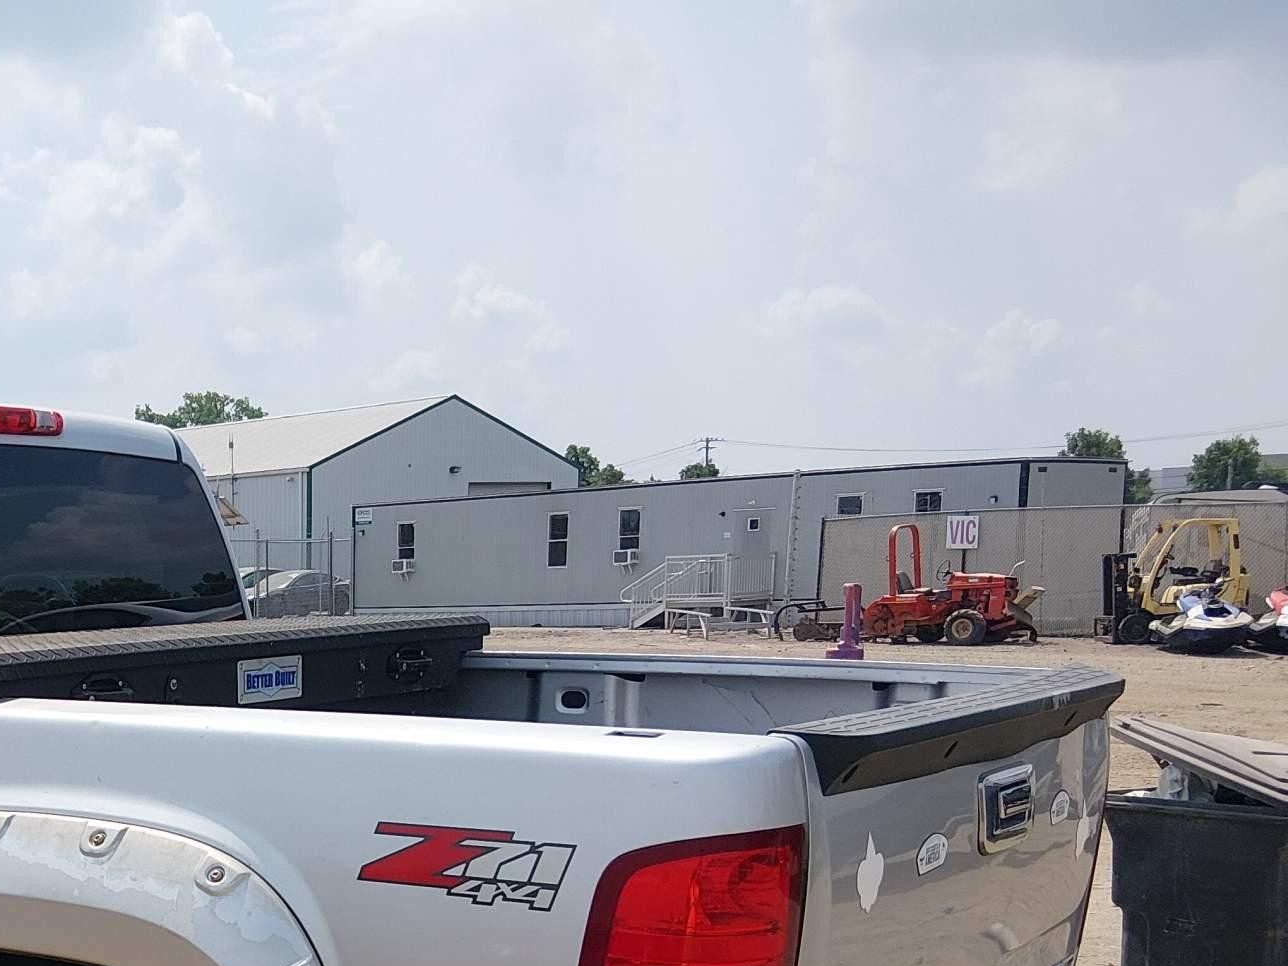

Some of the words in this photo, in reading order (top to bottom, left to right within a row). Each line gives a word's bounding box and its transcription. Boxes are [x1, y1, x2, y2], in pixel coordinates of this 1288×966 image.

[949, 519, 977, 545] VIC
[246, 672, 274, 691] BETTER
[274, 670, 297, 687] BUILT
[357, 821, 577, 889] Z71
